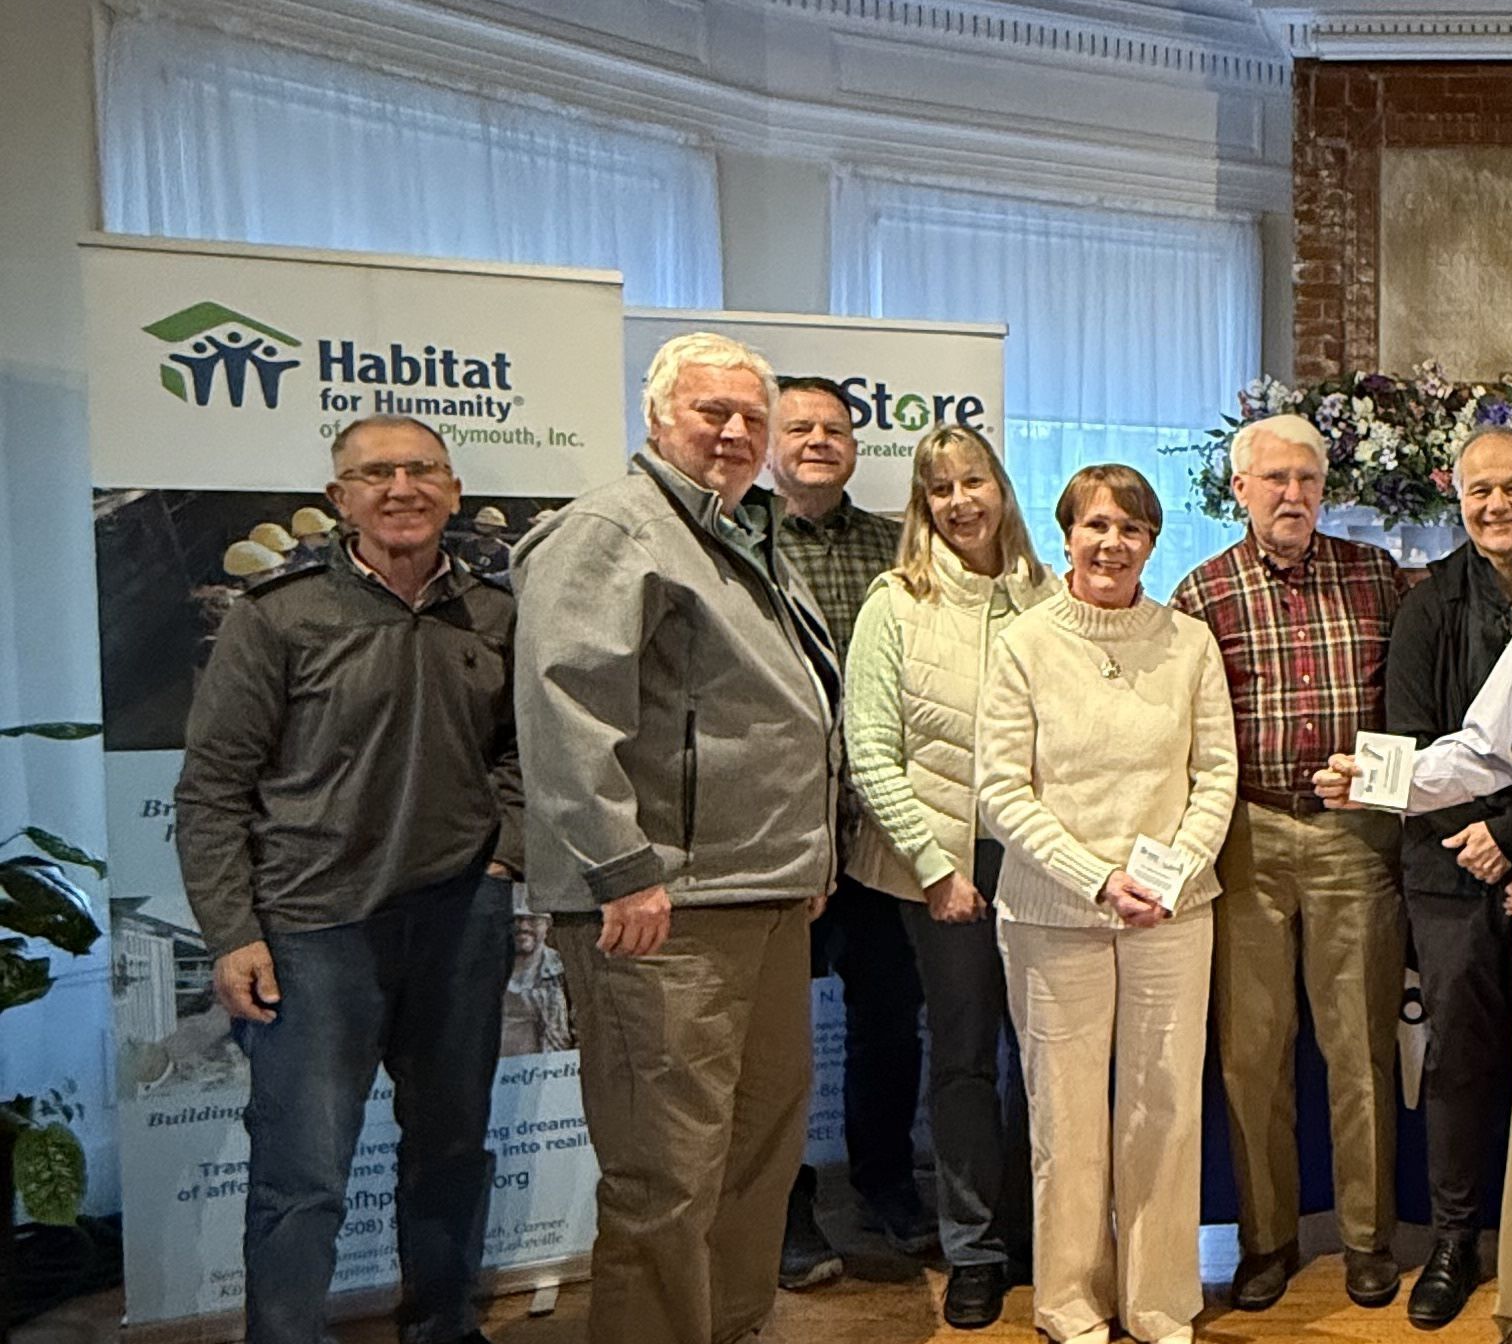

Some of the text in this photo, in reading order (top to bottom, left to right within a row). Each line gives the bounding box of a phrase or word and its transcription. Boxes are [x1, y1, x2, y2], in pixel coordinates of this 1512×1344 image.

[318, 339, 512, 391] Habitat
[320, 387, 514, 423] for Humanity
[841, 377, 985, 431] Store
[439, 422, 541, 448] Plymouth,
[549, 427, 585, 448] Inc.
[502, 1141, 541, 1157] into
